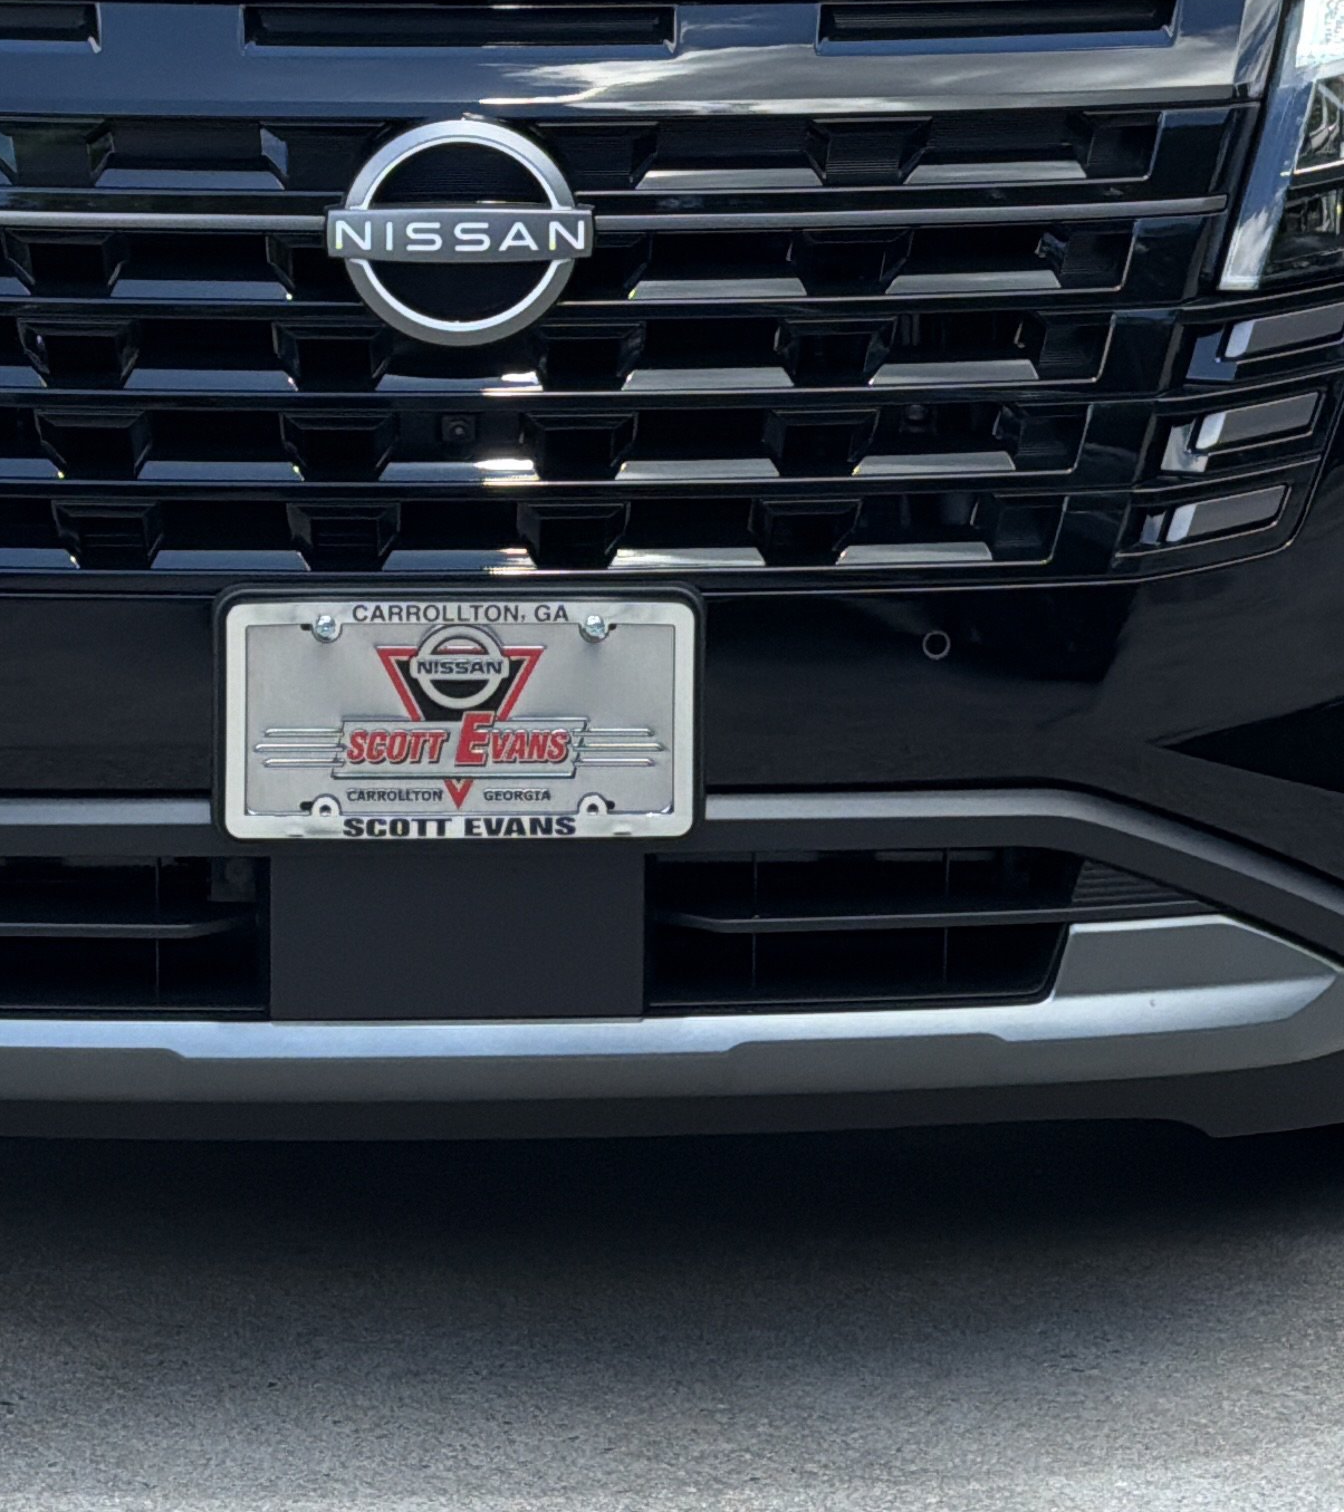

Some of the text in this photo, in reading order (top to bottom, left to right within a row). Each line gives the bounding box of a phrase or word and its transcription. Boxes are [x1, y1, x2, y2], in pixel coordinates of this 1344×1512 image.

[335, 220, 585, 251] NISSAN
[352, 604, 569, 623] CARROLLTON, GA
[416, 661, 504, 675] NISSAN
[346, 711, 572, 767] SCOTT EVANS
[347, 789, 551, 802] CARROLLTON GEORGIA
[343, 816, 577, 837] SCOTT EVANS
